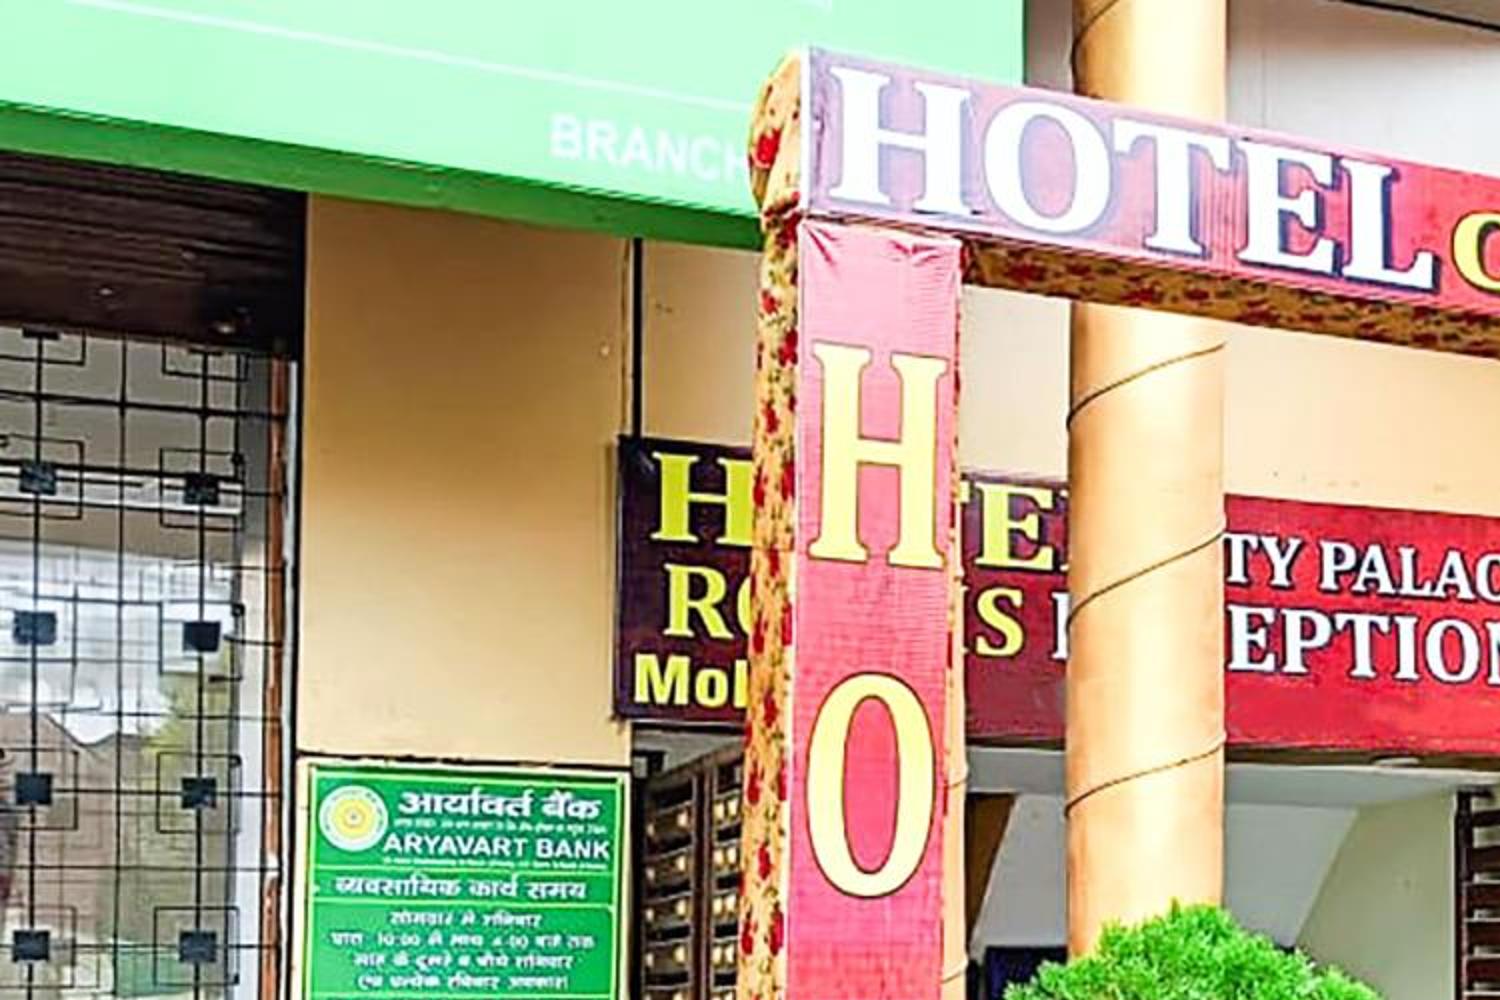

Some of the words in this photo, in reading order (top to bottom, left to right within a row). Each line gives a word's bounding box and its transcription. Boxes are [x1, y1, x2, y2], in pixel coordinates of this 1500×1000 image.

[549, 113, 749, 182] BRANCH
[829, 66, 1437, 290] HOTEL
[384, 833, 528, 857] ARYAVART
[536, 837, 610, 860] BANK
